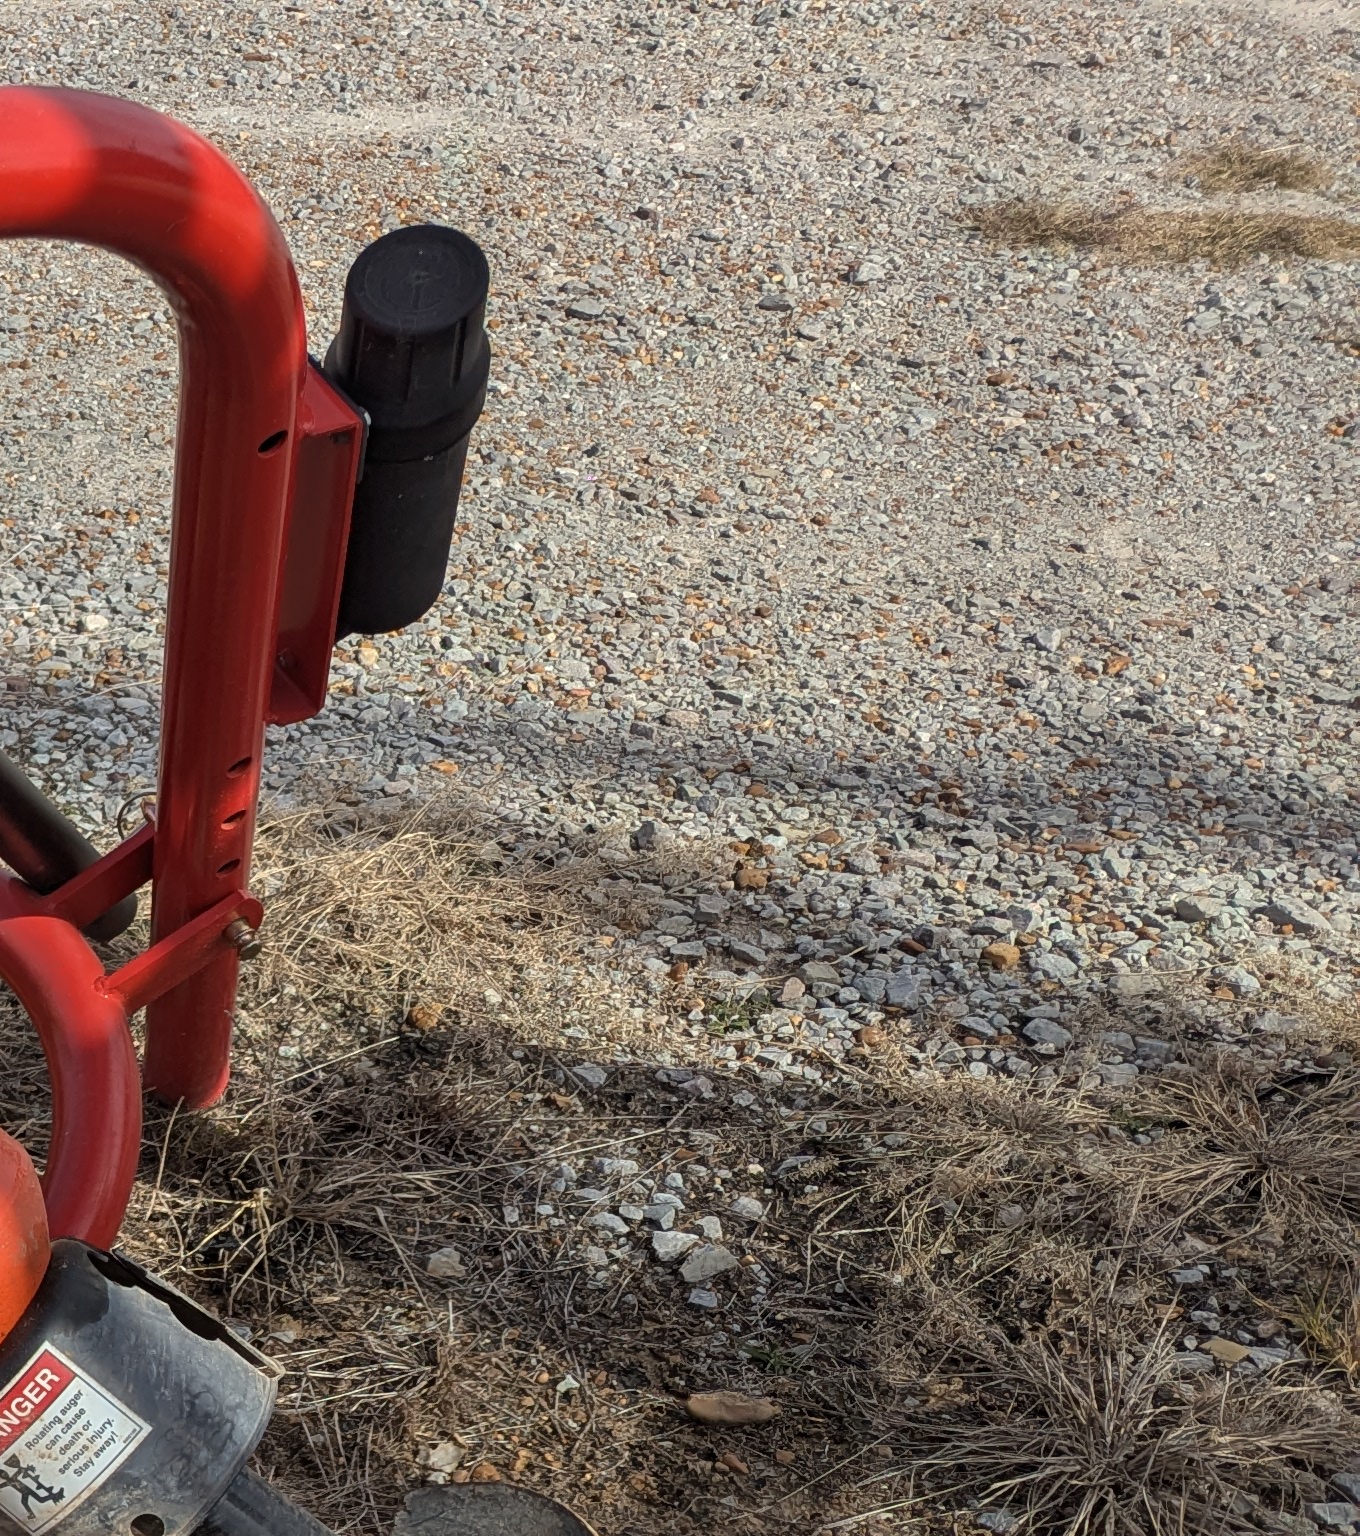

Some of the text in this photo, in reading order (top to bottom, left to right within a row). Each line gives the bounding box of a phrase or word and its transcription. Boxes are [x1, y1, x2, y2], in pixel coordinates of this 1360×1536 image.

[25, 1389, 84, 1450] Rotating auger
[45, 1407, 86, 1451] can cause
[59, 1419, 93, 1456] death or
[58, 1418, 114, 1475] serious injury.
[73, 1431, 119, 1478] Stay away!
